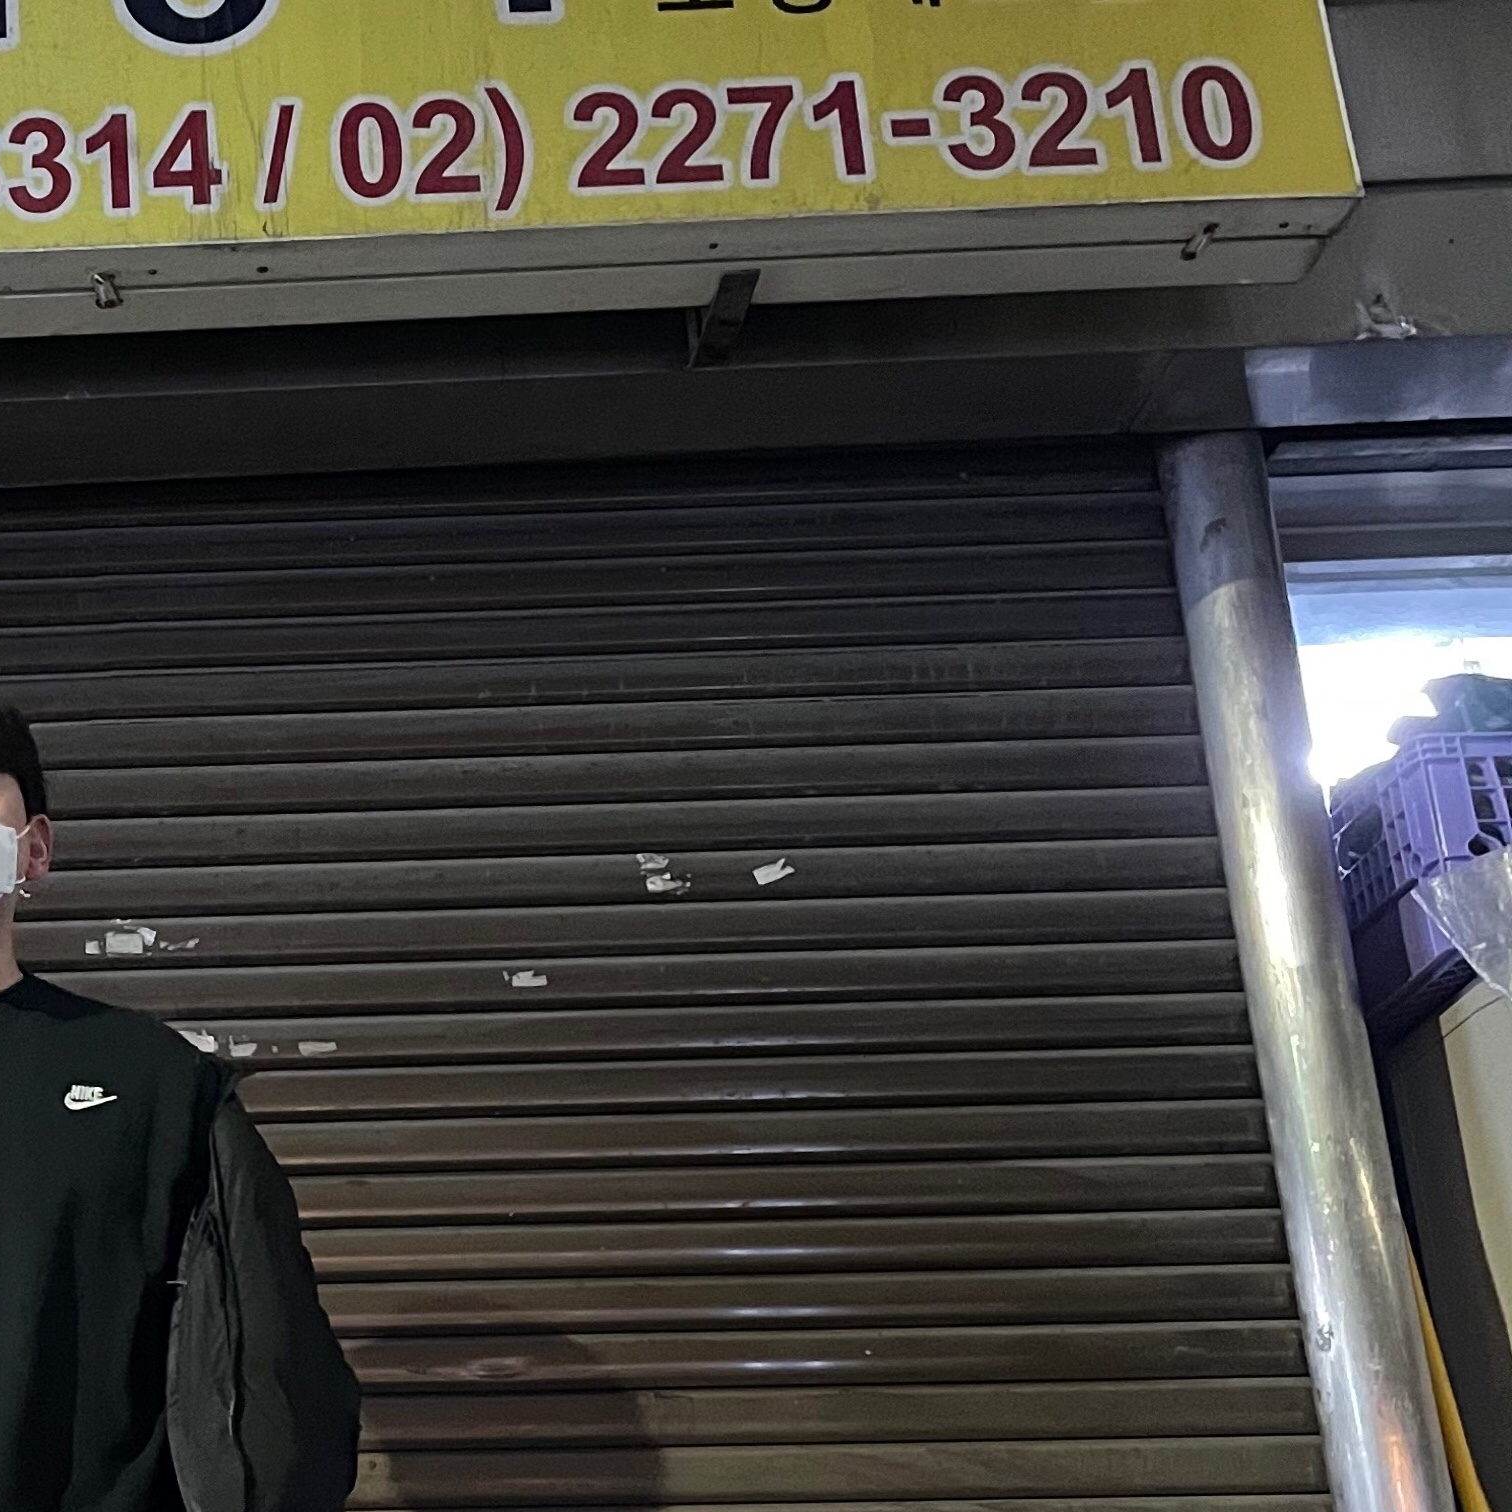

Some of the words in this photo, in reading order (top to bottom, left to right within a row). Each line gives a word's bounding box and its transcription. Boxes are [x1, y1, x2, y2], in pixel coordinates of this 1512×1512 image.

[338, 87, 524, 211] 02)
[574, 67, 1251, 188] 2271-3210
[70, 1084, 104, 1101] NIKE
